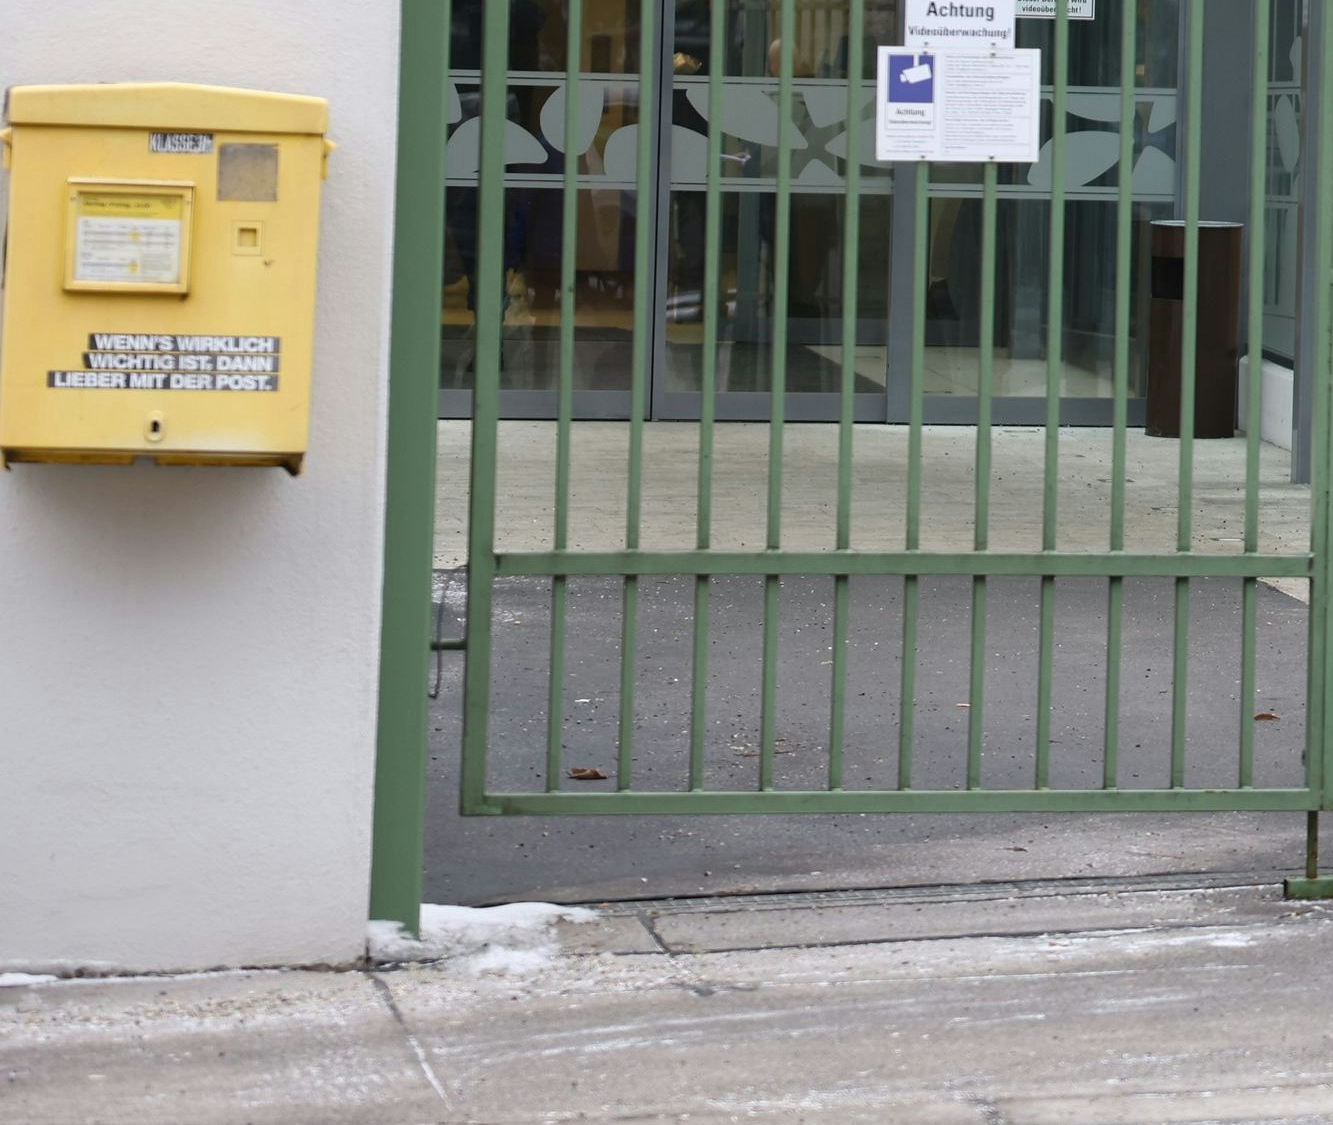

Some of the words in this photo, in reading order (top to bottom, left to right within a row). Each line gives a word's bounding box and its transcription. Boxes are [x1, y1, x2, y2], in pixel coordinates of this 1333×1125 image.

[926, 1, 995, 22] Achtung
[908, 25, 1012, 40] Videoüberwachung!
[94, 334, 175, 352] WENN'S
[176, 336, 274, 353] WIRKLICH
[88, 353, 176, 370] WICHTIG
[216, 355, 274, 372] DANN
[54, 372, 127, 388] LIEBER
[129, 373, 167, 389] MIT
[170, 374, 213, 390] DER
[215, 375, 273, 391] POST.
